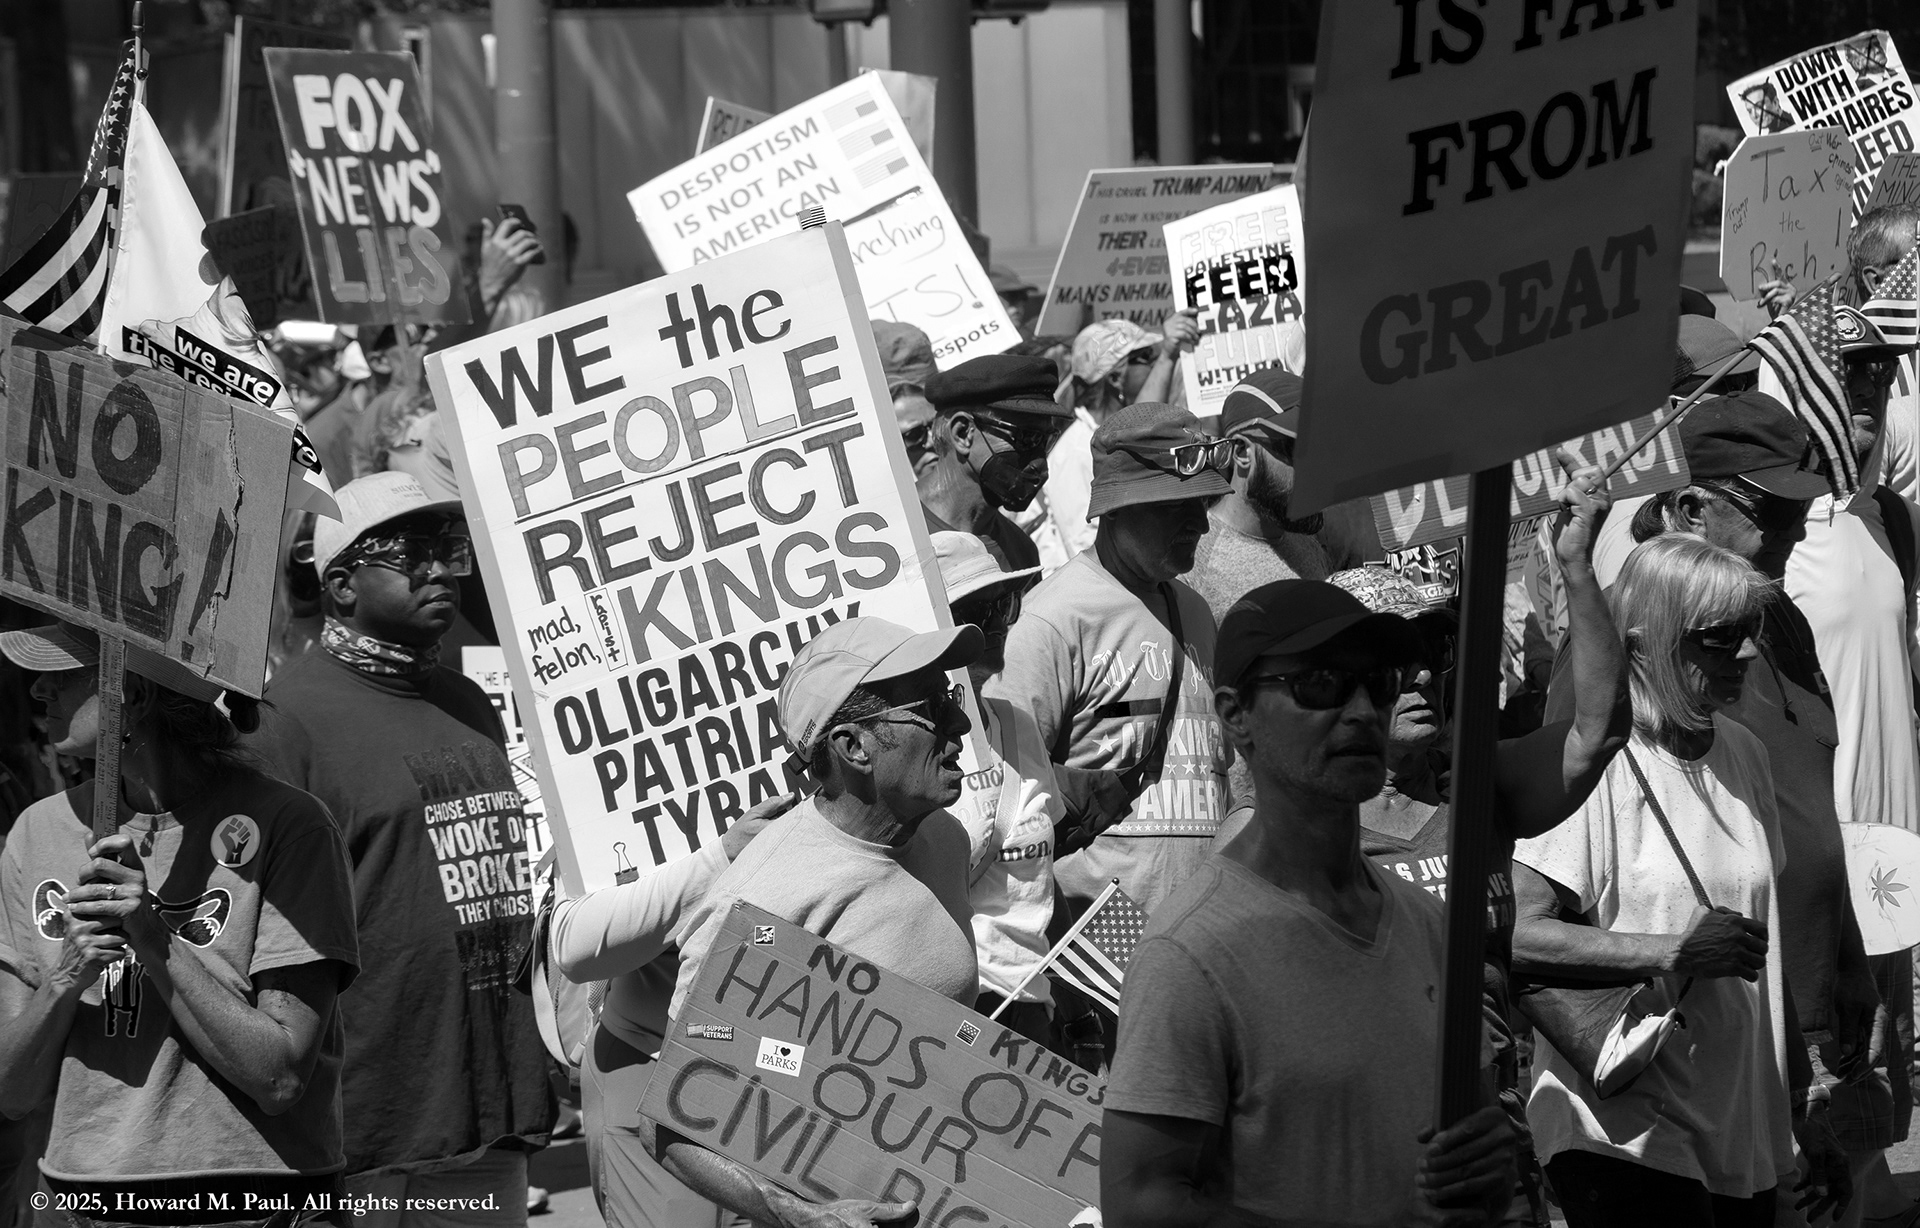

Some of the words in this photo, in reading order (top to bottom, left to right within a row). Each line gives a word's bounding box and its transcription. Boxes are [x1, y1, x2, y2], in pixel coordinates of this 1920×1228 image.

[1775, 46, 1843, 93] DOWN
[1787, 69, 1856, 122] WITH
[293, 73, 419, 152] FOX
[658, 116, 821, 212] DESPOTISM
[1403, 67, 1657, 217] FROM
[673, 211, 701, 241] IS
[707, 172, 766, 223] NOT
[775, 152, 820, 190] AN
[1152, 176, 1211, 197] TRUMP
[1750, 146, 1830, 203] Tax
[690, 176, 842, 267] AMERICAN
[1098, 230, 1148, 250] THEIR
[1180, 205, 1290, 268] FREE
[1779, 212, 1806, 233] the
[322, 227, 451, 306] LIES
[1360, 224, 1658, 385] GREAT
[129, 333, 175, 371] the
[178, 335, 217, 372] we
[223, 364, 276, 404] are
[463, 316, 626, 430] WE
[659, 283, 792, 369] the
[27, 349, 162, 496] NO
[496, 336, 855, 519] PEOPLE
[522, 422, 864, 604] REJECT
[617, 511, 901, 665] KINGS
[527, 605, 582, 653] mad,
[590, 594, 620, 662] rapist
[532, 642, 602, 686] felon,
[424, 799, 465, 825] CHOSE
[427, 816, 503, 861] WOKE
[438, 851, 532, 903] BROKE
[454, 900, 491, 925] THEY
[807, 942, 881, 996] NO
[703, 1032, 733, 1040] VETERANS
[706, 1025, 733, 1033] SUPPORT
[715, 942, 947, 1090] HANDS
[761, 1054, 797, 1071] PARKS
[774, 1045, 781, 1055] I
[812, 1062, 979, 1184] OUR
